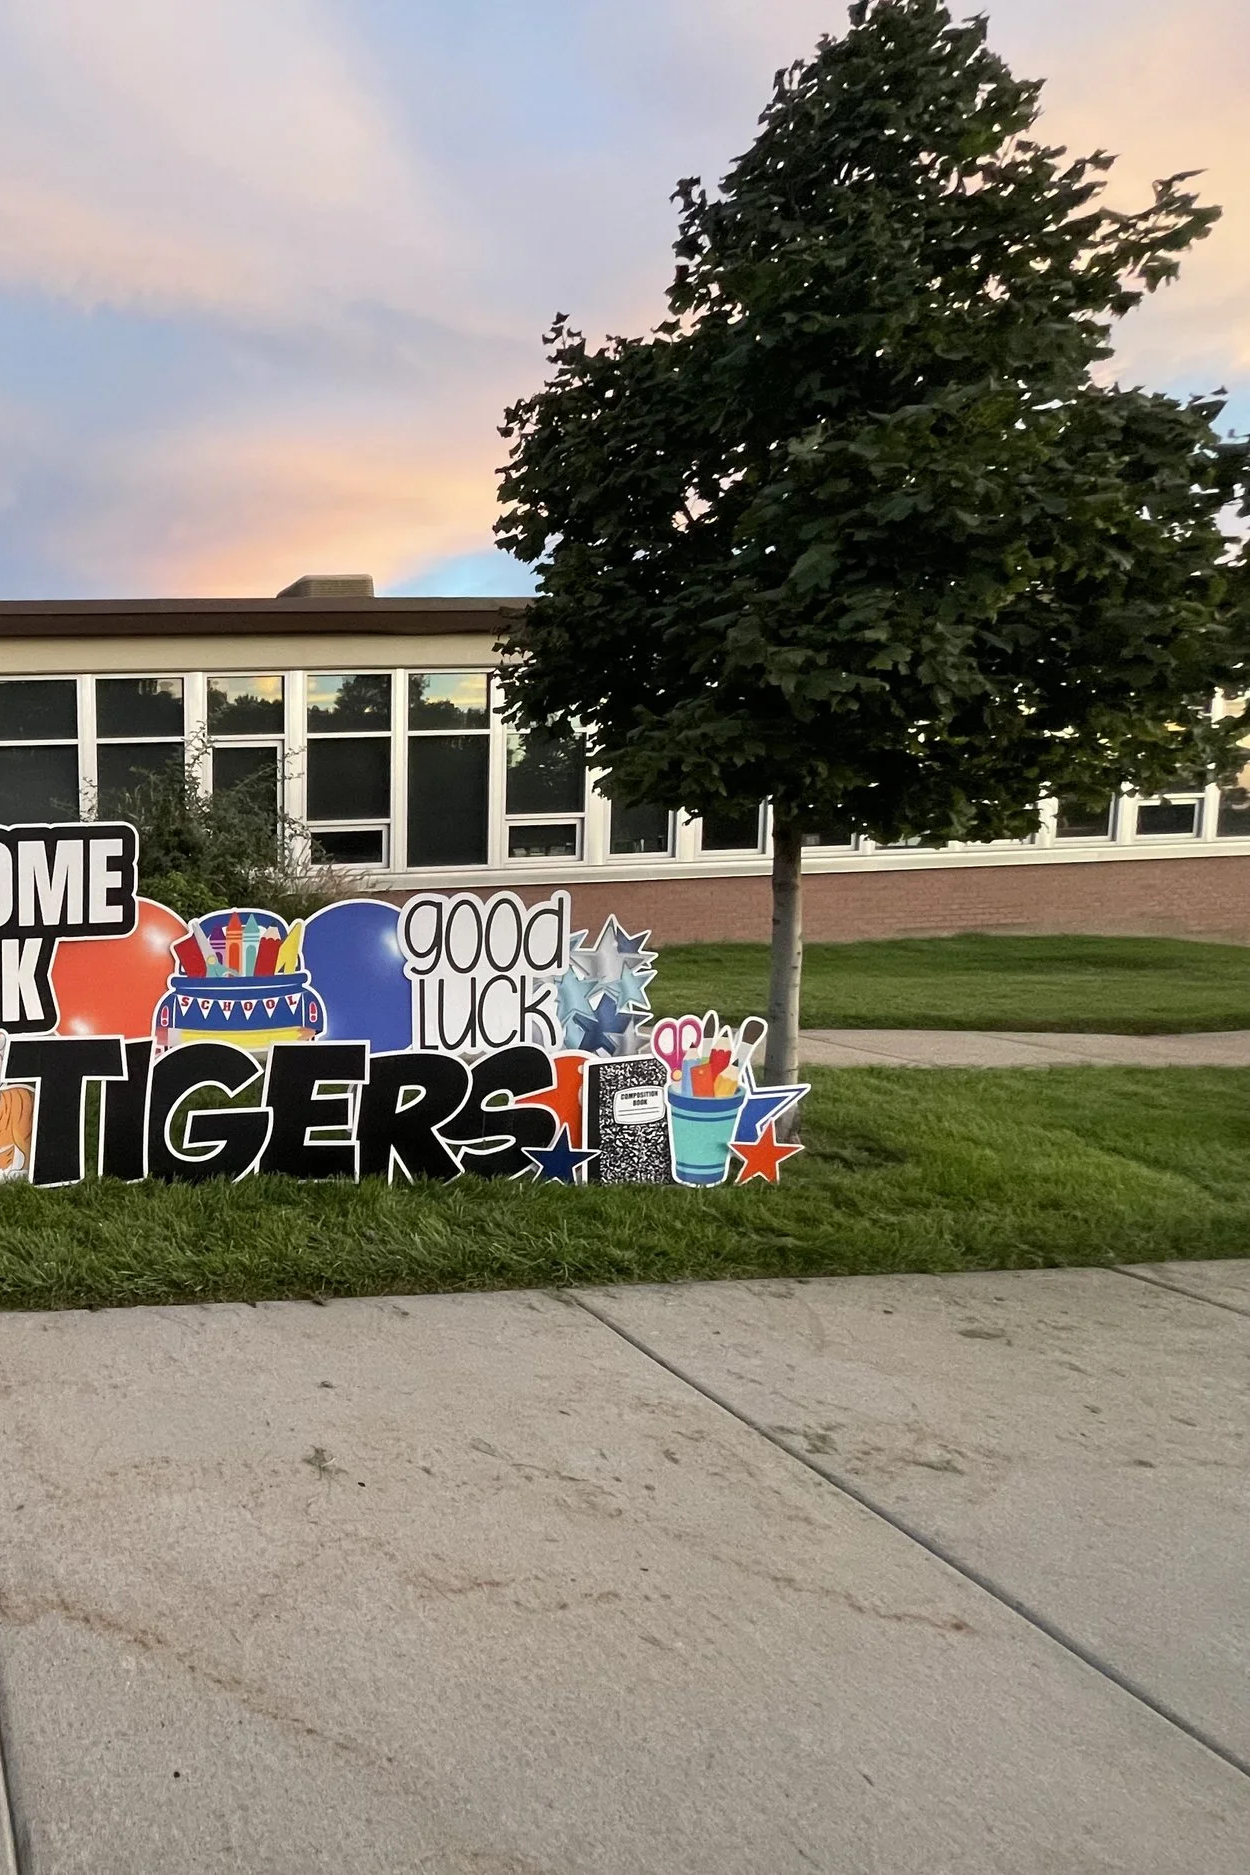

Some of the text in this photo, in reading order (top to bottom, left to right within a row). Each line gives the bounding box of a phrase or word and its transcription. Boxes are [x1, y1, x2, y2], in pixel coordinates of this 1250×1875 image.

[181, 995, 297, 1012] SCHOOL
[620, 1091, 658, 1100] COMPOSITION
[6, 1038, 557, 1186] TIGERS
